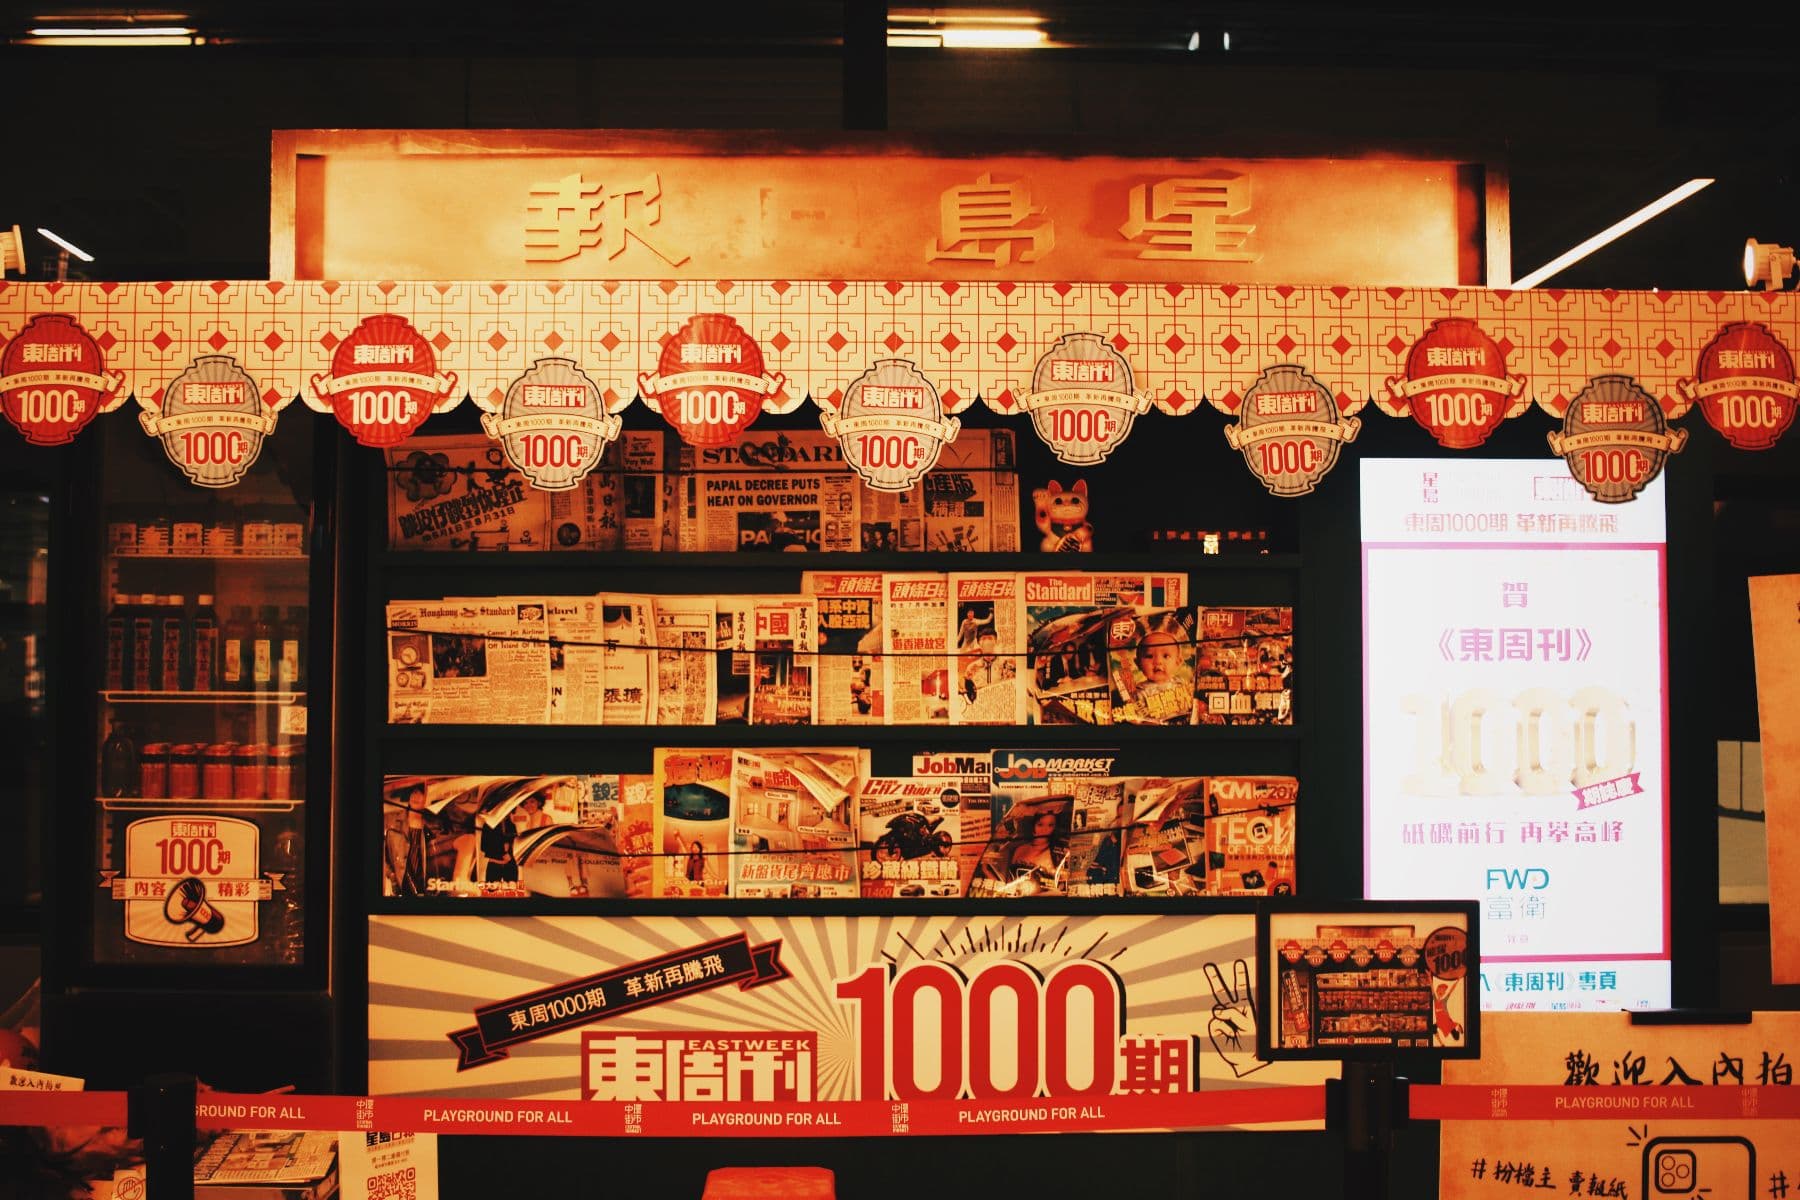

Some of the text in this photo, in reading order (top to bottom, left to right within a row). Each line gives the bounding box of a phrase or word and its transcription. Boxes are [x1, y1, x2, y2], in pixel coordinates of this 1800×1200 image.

[706, 478, 820, 491] PAPAL DECREE PUTS
[707, 494, 818, 507] HEAT ON GOVERNOR
[1049, 578, 1063, 588] The
[1026, 582, 1091, 602] Standard
[1502, 582, 1528, 608] 賀
[479, 606, 516, 616] Standard
[1438, 627, 1593, 663] 《東周刊》
[1210, 780, 1251, 800] PCM
[1520, 820, 1624, 844] 再攀高峰
[1486, 867, 1550, 890] FWD
[134, 881, 250, 897] 內容 精彩
[508, 953, 726, 1032] 東周1000期 革新再騰飛
[688, 1039, 811, 1051] EASTWEEK
[588, 1035, 811, 1102] 東周刊
[1555, 1096, 1694, 1109] PLAYGROUND FOR ALL
[250, 1106, 276, 1118] FOR
[280, 1107, 305, 1119] ALL
[423, 1108, 573, 1124] PLAYGROUND FOR ALL
[691, 1112, 842, 1126] PLAYGROUND FOR ALL
[958, 1106, 1106, 1124] PLAYGROUND FOR ALL
